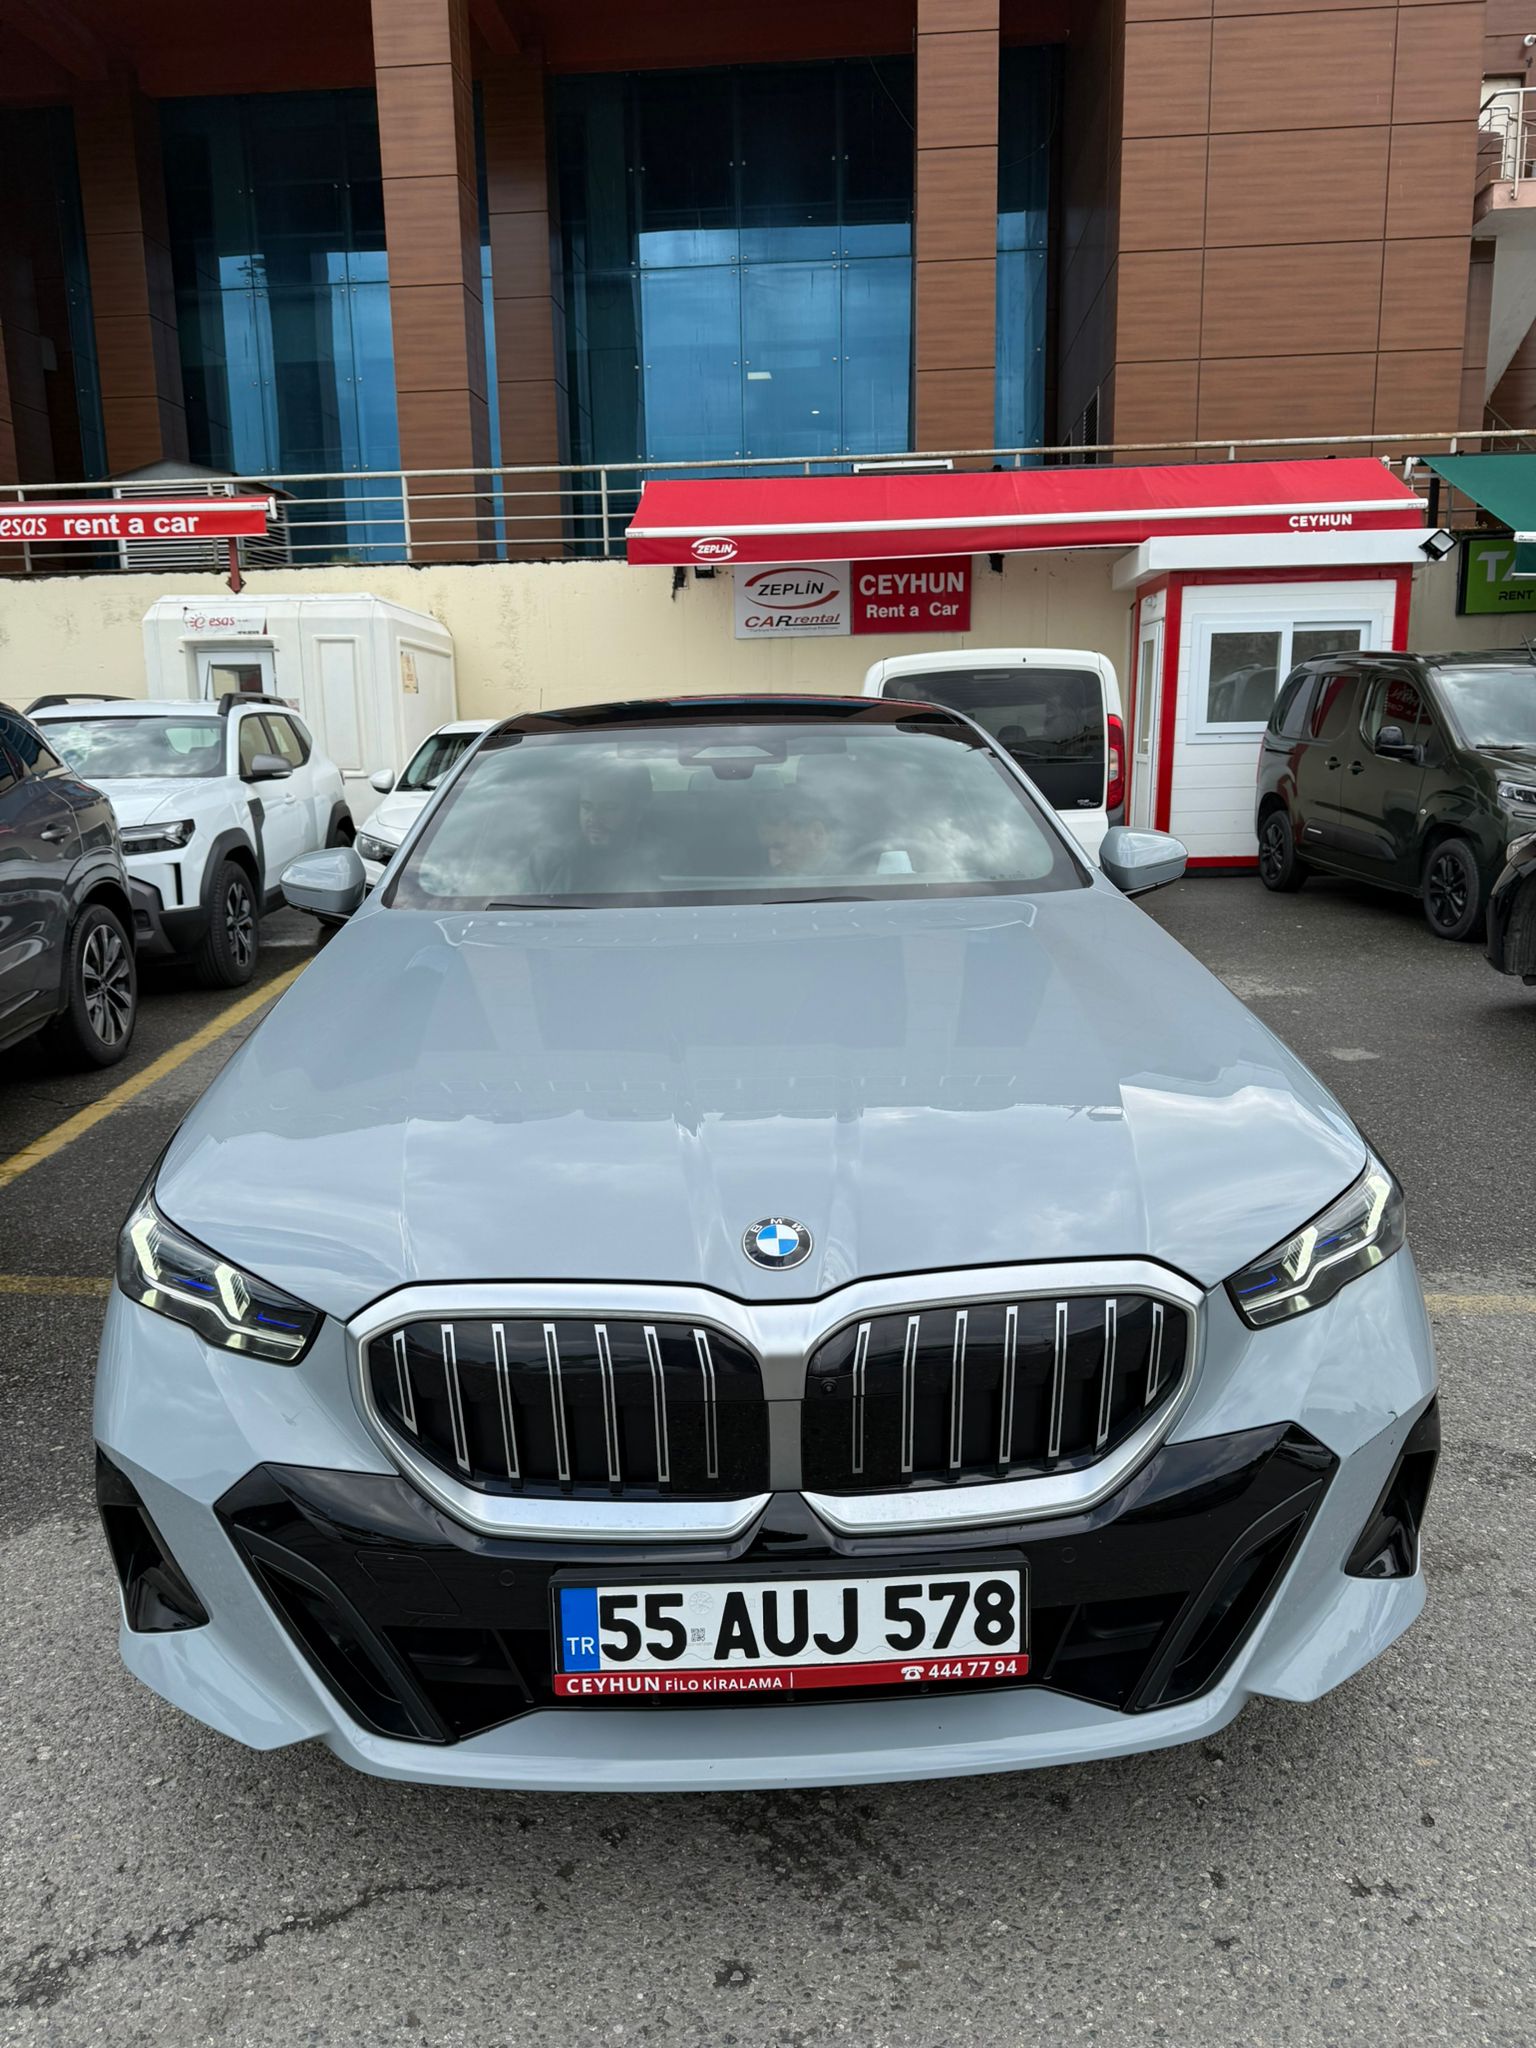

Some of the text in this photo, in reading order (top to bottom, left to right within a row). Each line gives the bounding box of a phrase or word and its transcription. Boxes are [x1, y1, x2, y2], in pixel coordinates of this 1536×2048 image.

[0, 514, 199, 536] esas rent a car
[1289, 514, 1353, 527] CEYHUN
[758, 580, 824, 596] ZEPLİN
[859, 572, 964, 596] CEYHUN
[1498, 590, 1534, 600] RENT
[866, 602, 959, 618] Rent a Car
[208, 617, 235, 626] esas
[750, 1218, 804, 1233] BMW
[599, 1579, 1015, 1662] 55 AUJ 578
[566, 1636, 595, 1655] TR
[566, 1660, 1018, 1693] CEYHUN FİLO KİRALAMA 444 77 94
